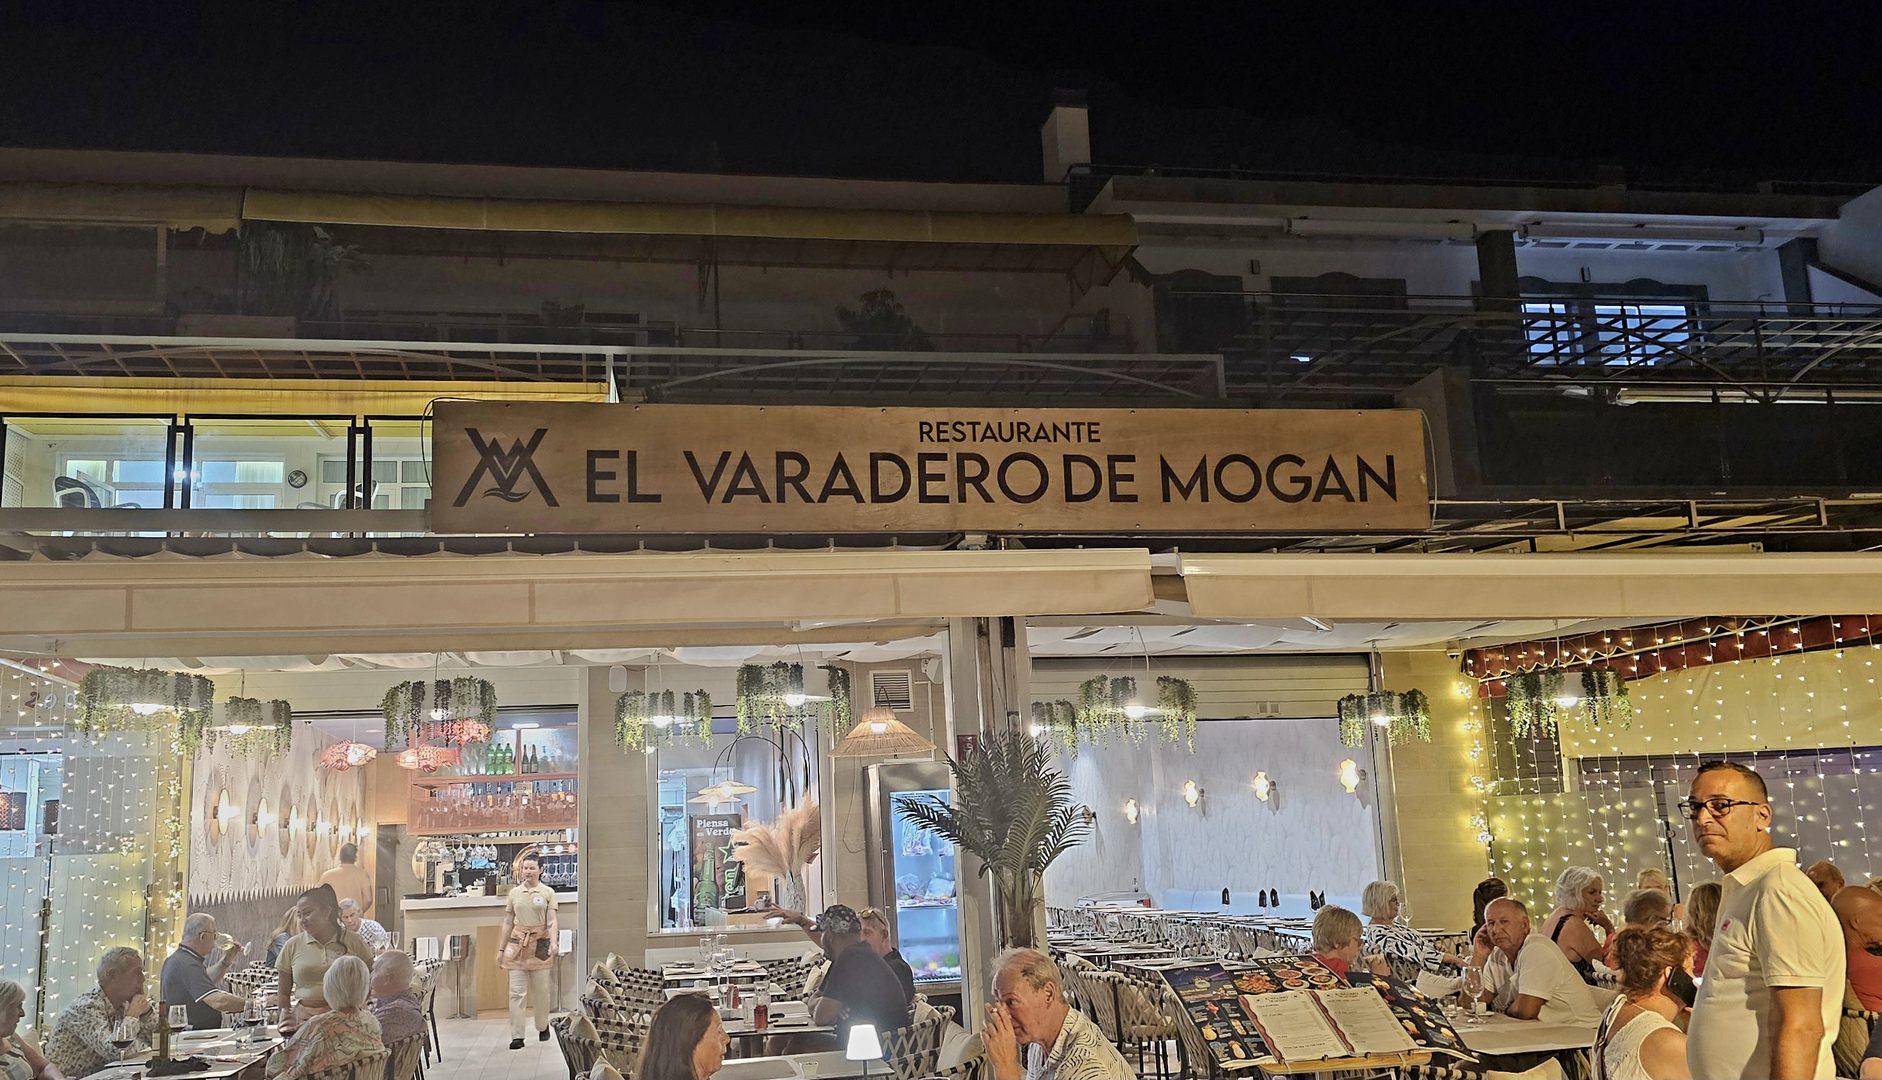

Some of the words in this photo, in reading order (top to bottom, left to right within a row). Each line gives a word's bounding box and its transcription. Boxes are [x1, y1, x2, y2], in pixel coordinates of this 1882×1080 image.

[919, 421, 1102, 443] RESTAURANTE
[586, 449, 662, 503] EL
[683, 450, 1050, 504] VARADERO
[1063, 453, 1139, 503] DE
[1160, 453, 1398, 504] MOGAN
[697, 819, 729, 828] Piensa
